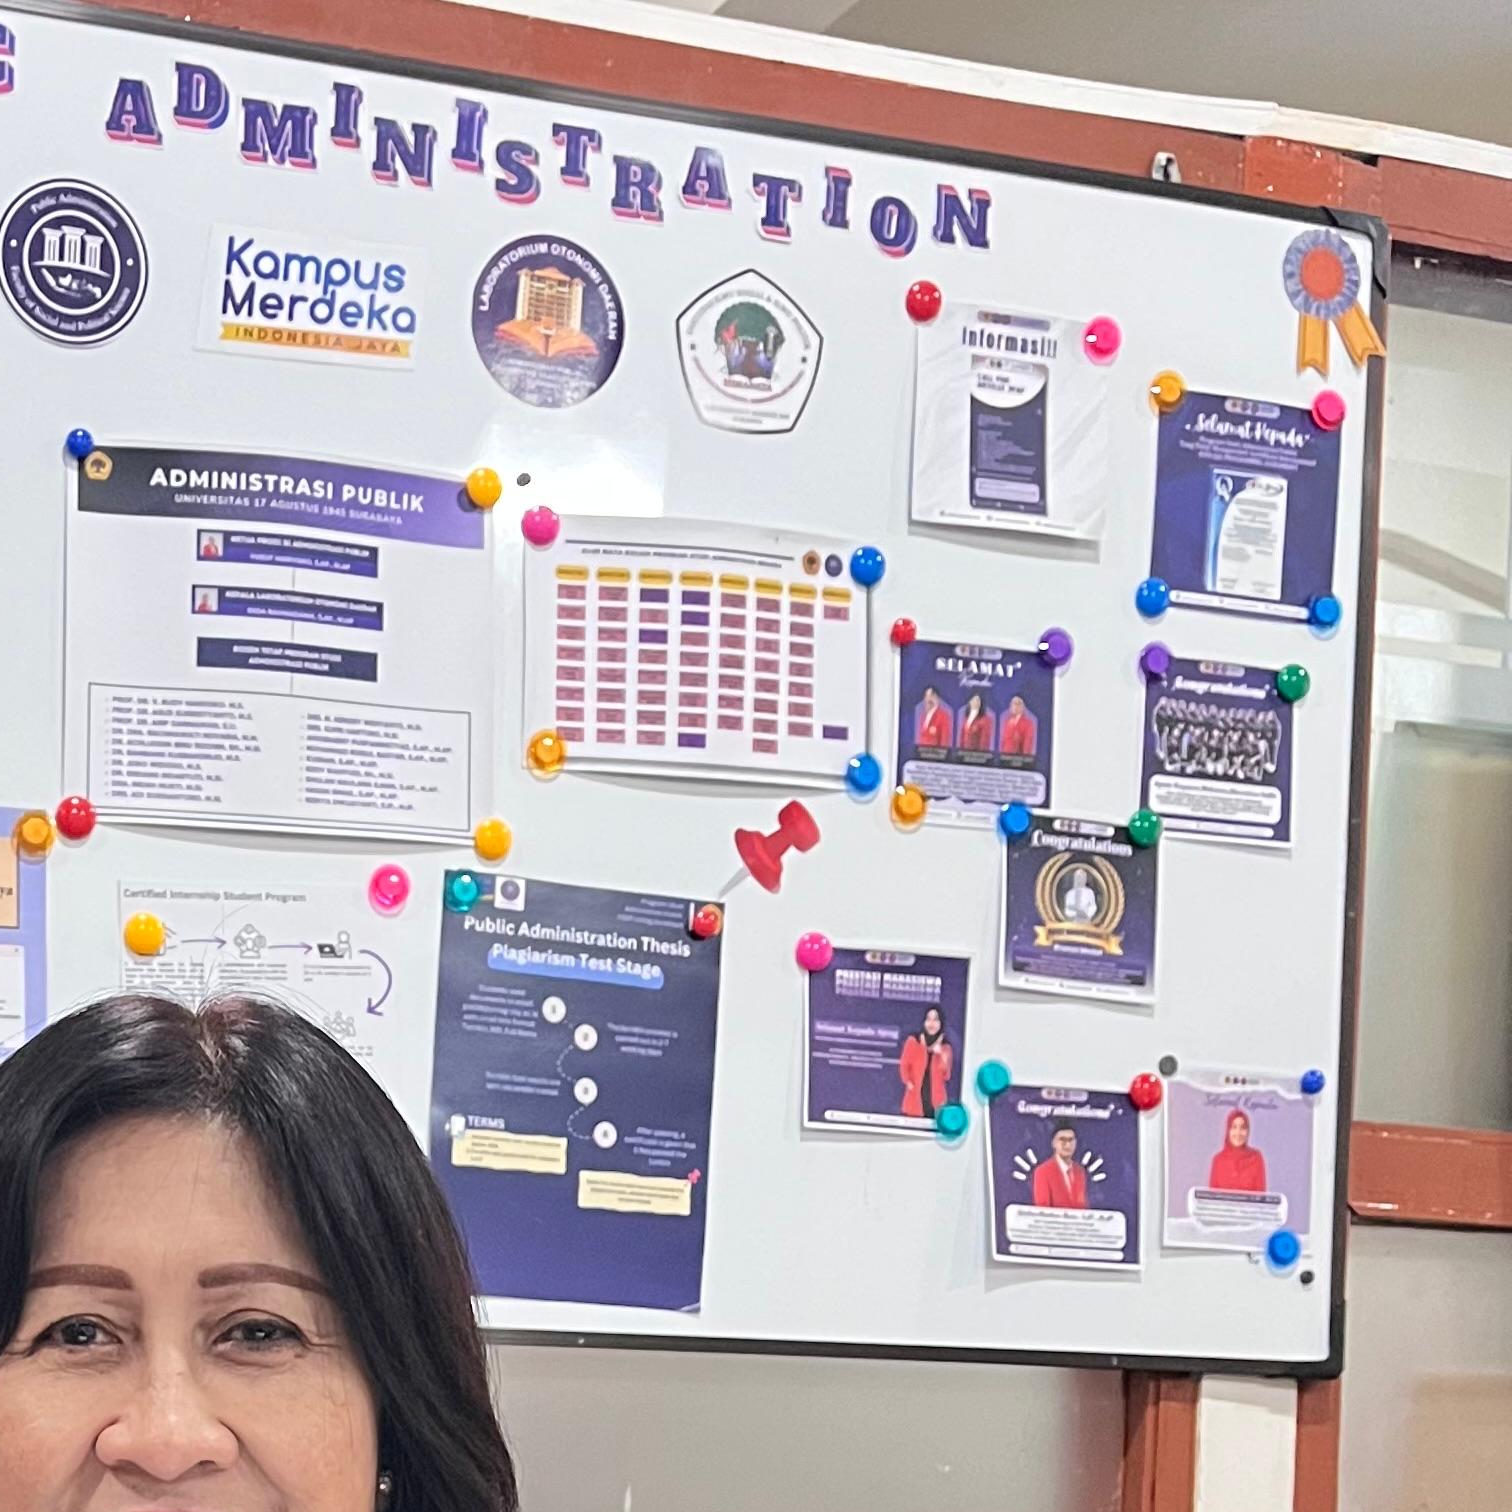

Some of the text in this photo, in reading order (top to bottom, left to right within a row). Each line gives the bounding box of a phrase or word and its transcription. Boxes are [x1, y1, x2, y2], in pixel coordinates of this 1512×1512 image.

[105, 62, 992, 257] ADMINISTRATION
[225, 235, 406, 294] Kampus
[479, 242, 549, 312] LABORATORIUM
[221, 279, 416, 335] Merdeka
[235, 325, 402, 356] INDONESIA JAYA
[1196, 412, 1253, 440] Selamat
[149, 467, 425, 513] ADMINISTRASI PUBLIK
[174, 492, 250, 507] UNIVERSITAS
[254, 498, 266, 508] 17
[269, 499, 320, 515] AGUSTUS
[935, 657, 1014, 678] SELAMAT
[1031, 829, 1133, 857] Congratulations
[123, 888, 168, 898] Certified
[169, 889, 221, 902] Internship
[464, 915, 692, 958] Public Administration Thesis
[491, 942, 662, 979] Plagiarism Test Stage
[467, 1114, 506, 1130] TERMS
